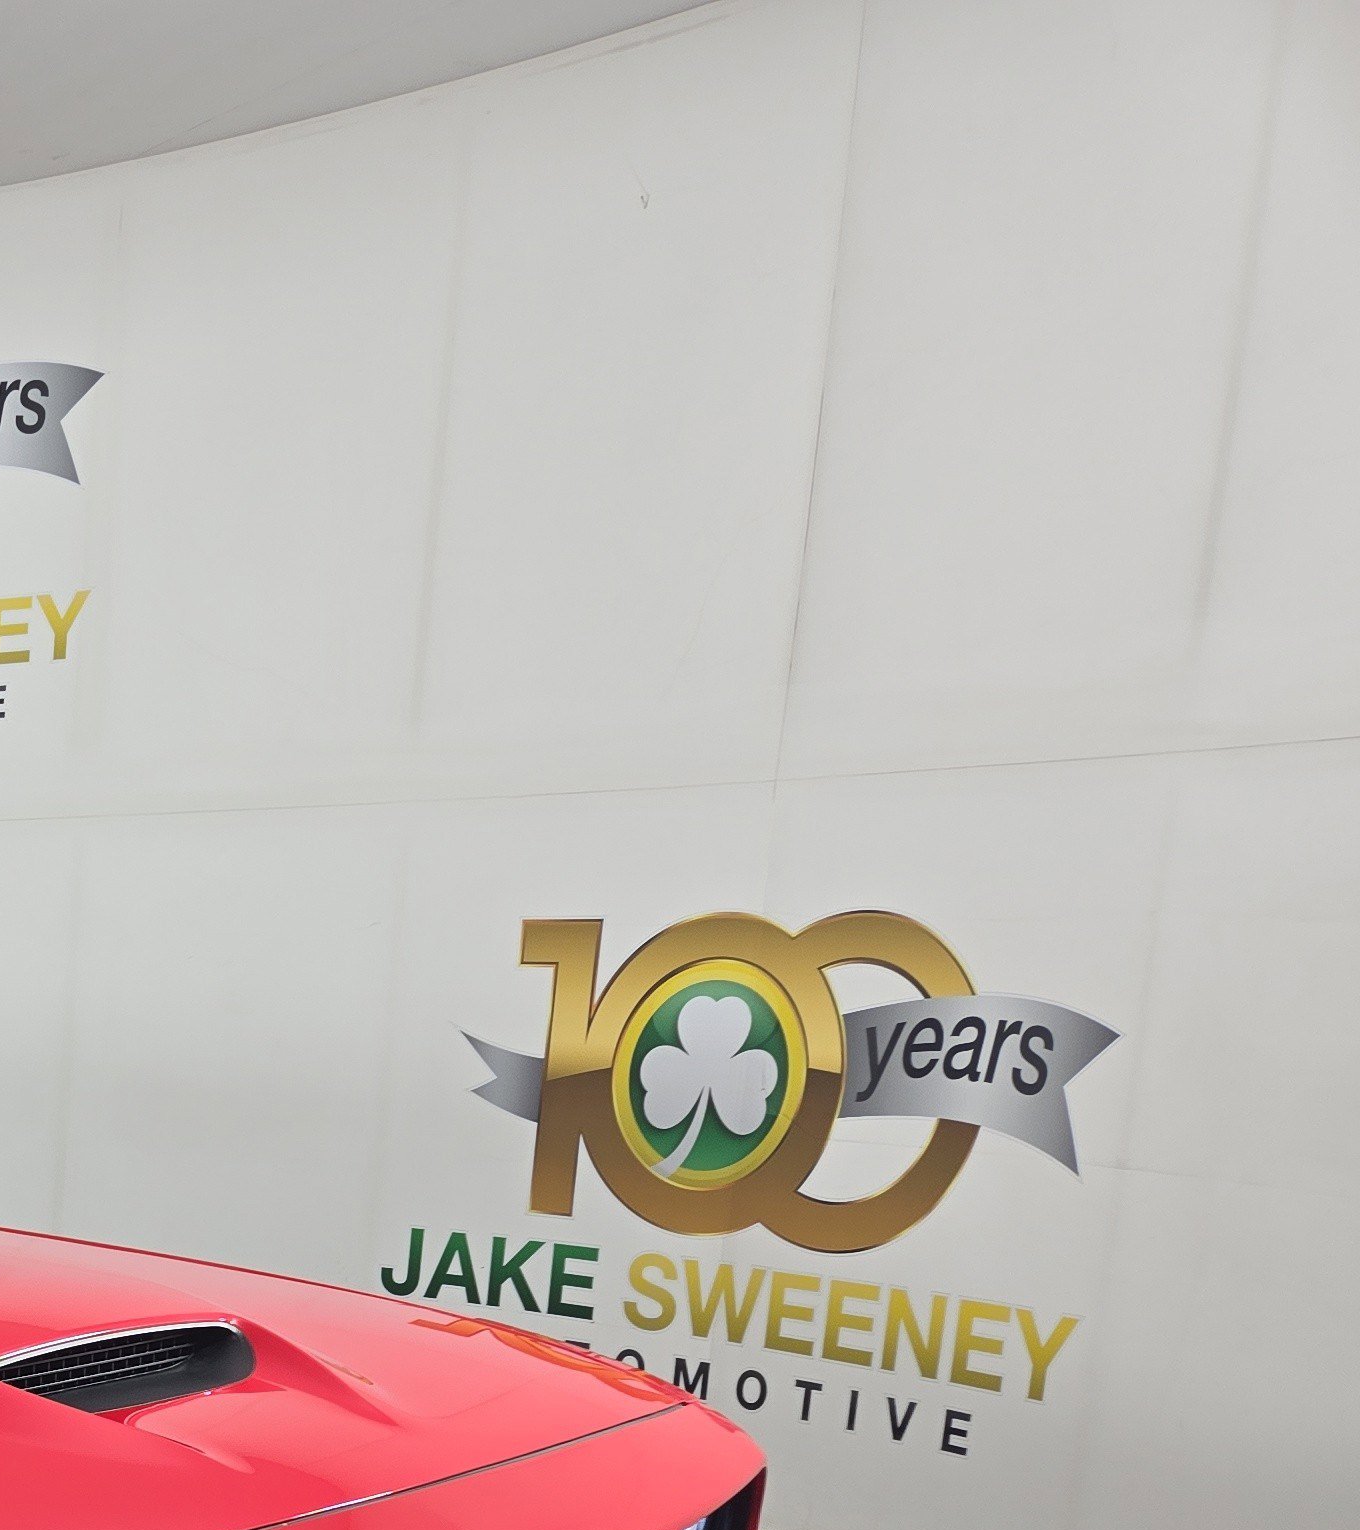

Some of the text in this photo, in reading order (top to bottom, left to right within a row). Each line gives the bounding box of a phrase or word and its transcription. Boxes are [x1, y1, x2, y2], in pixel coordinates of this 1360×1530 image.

[855, 1015, 1054, 1103] years
[381, 1227, 1079, 1402] JAKE SWEENEY
[565, 1338, 973, 1456] MOTIVE
